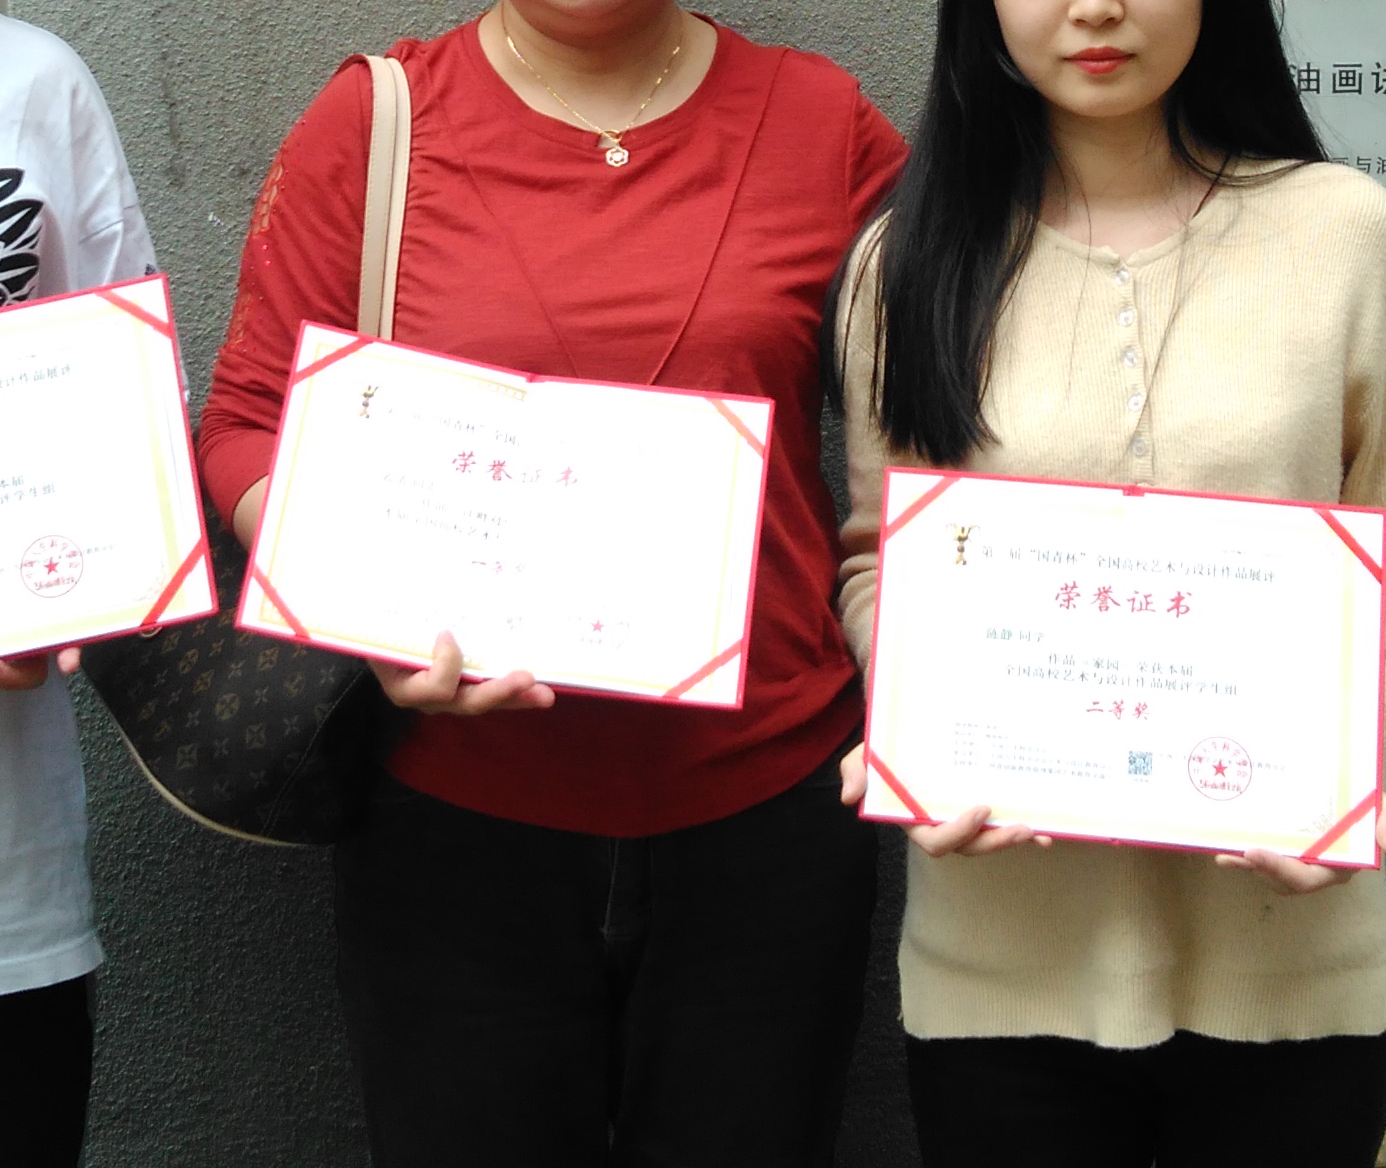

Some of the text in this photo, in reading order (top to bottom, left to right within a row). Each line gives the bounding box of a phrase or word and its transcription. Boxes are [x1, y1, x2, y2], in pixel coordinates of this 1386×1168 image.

[1054, 580, 1194, 619] 荣誉证书
[1085, 698, 1151, 721] 二等奖
